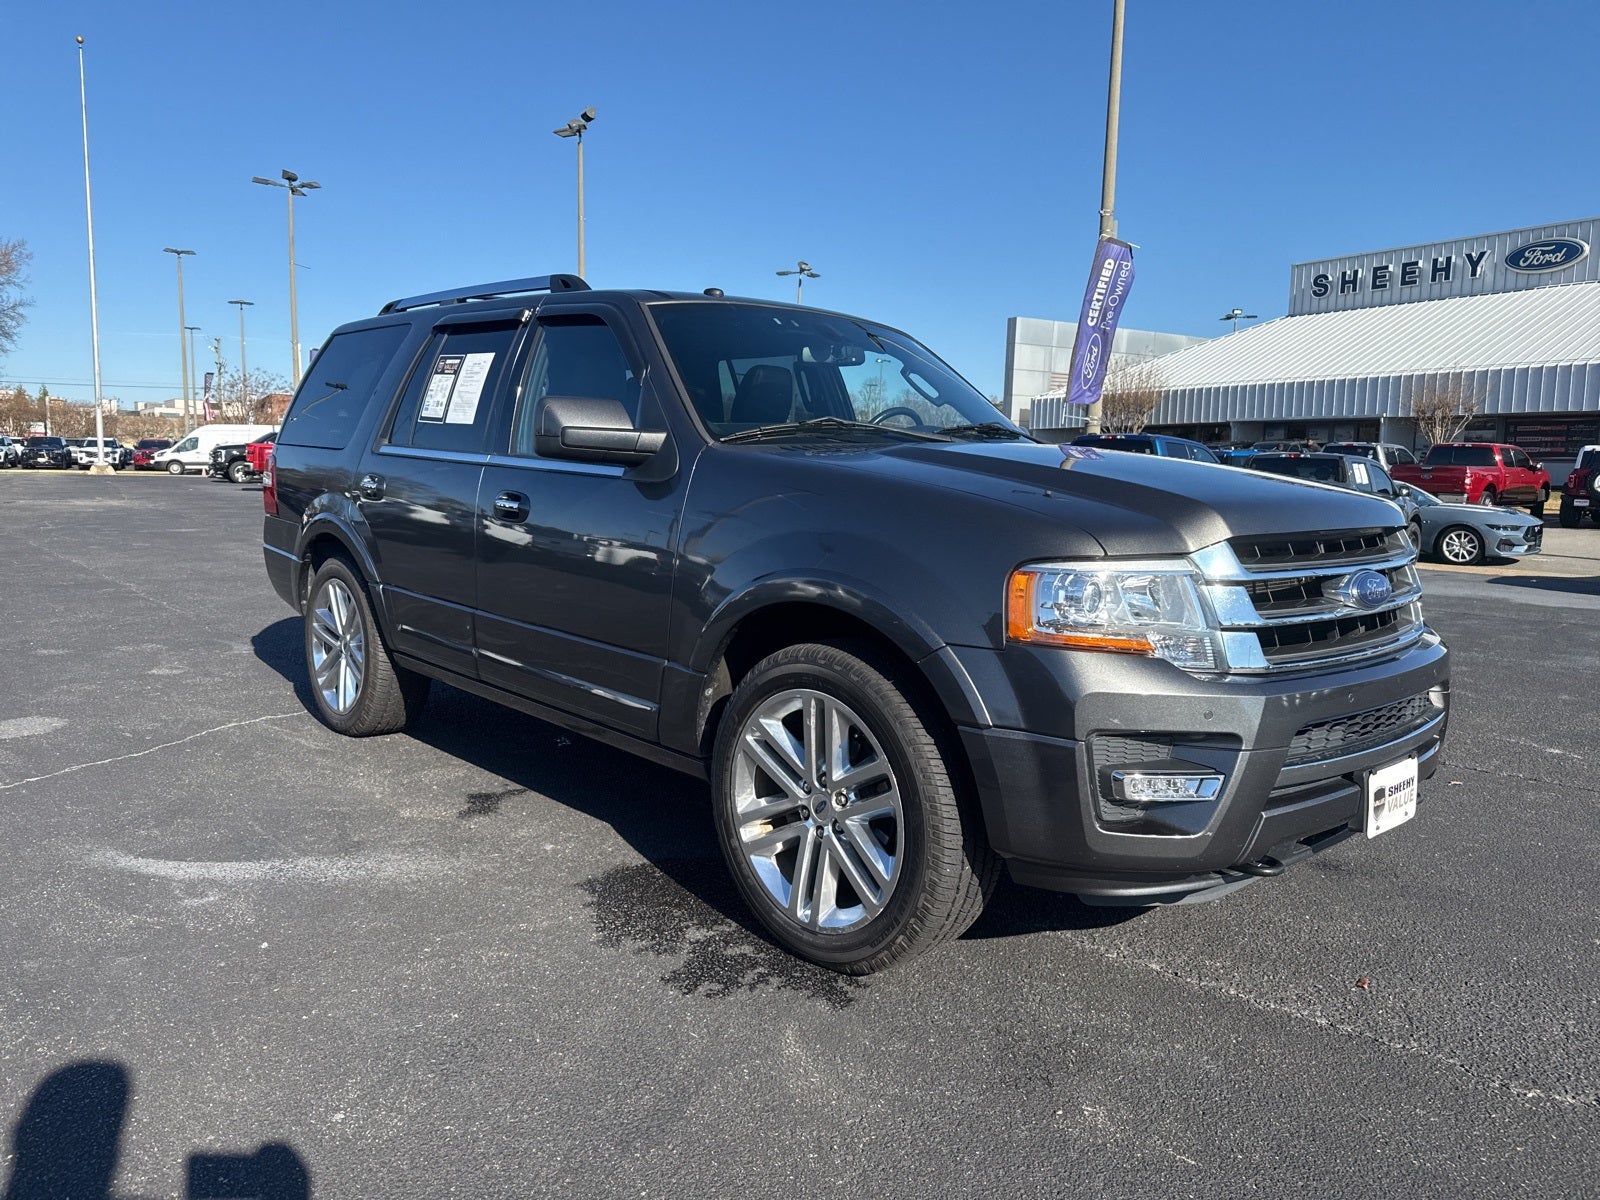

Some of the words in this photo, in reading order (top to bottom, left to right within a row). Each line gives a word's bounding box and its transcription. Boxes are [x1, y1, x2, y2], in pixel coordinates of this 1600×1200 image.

[1518, 244, 1566, 268] Ford
[1311, 249, 1492, 299] SHEEHY
[1087, 258, 1115, 327] CERTIFIED
[1101, 261, 1131, 330] Pre-Owned
[1083, 345, 1099, 379] Ford
[1387, 788, 1414, 813] VALUE
[1388, 776, 1415, 798] SHEEHY
